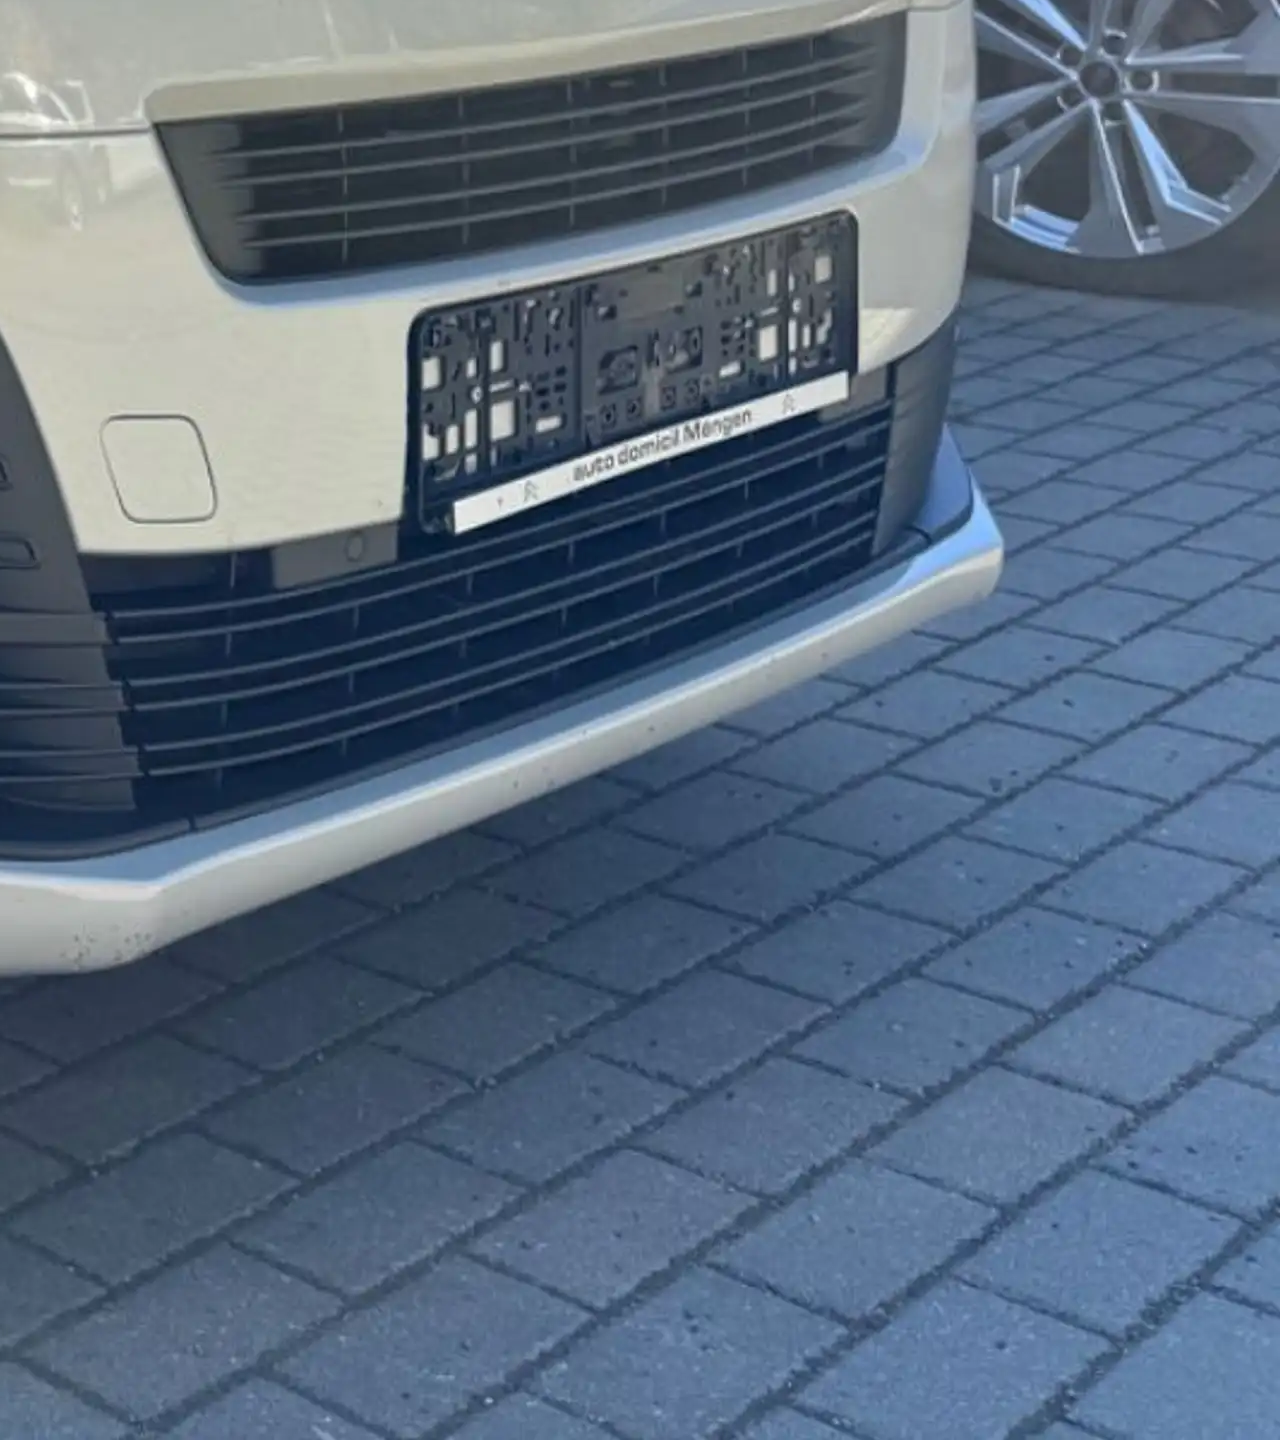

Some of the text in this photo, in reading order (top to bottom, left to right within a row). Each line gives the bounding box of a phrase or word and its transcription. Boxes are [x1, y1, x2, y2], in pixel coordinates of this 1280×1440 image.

[573, 410, 751, 481] auto domicil Mengen
